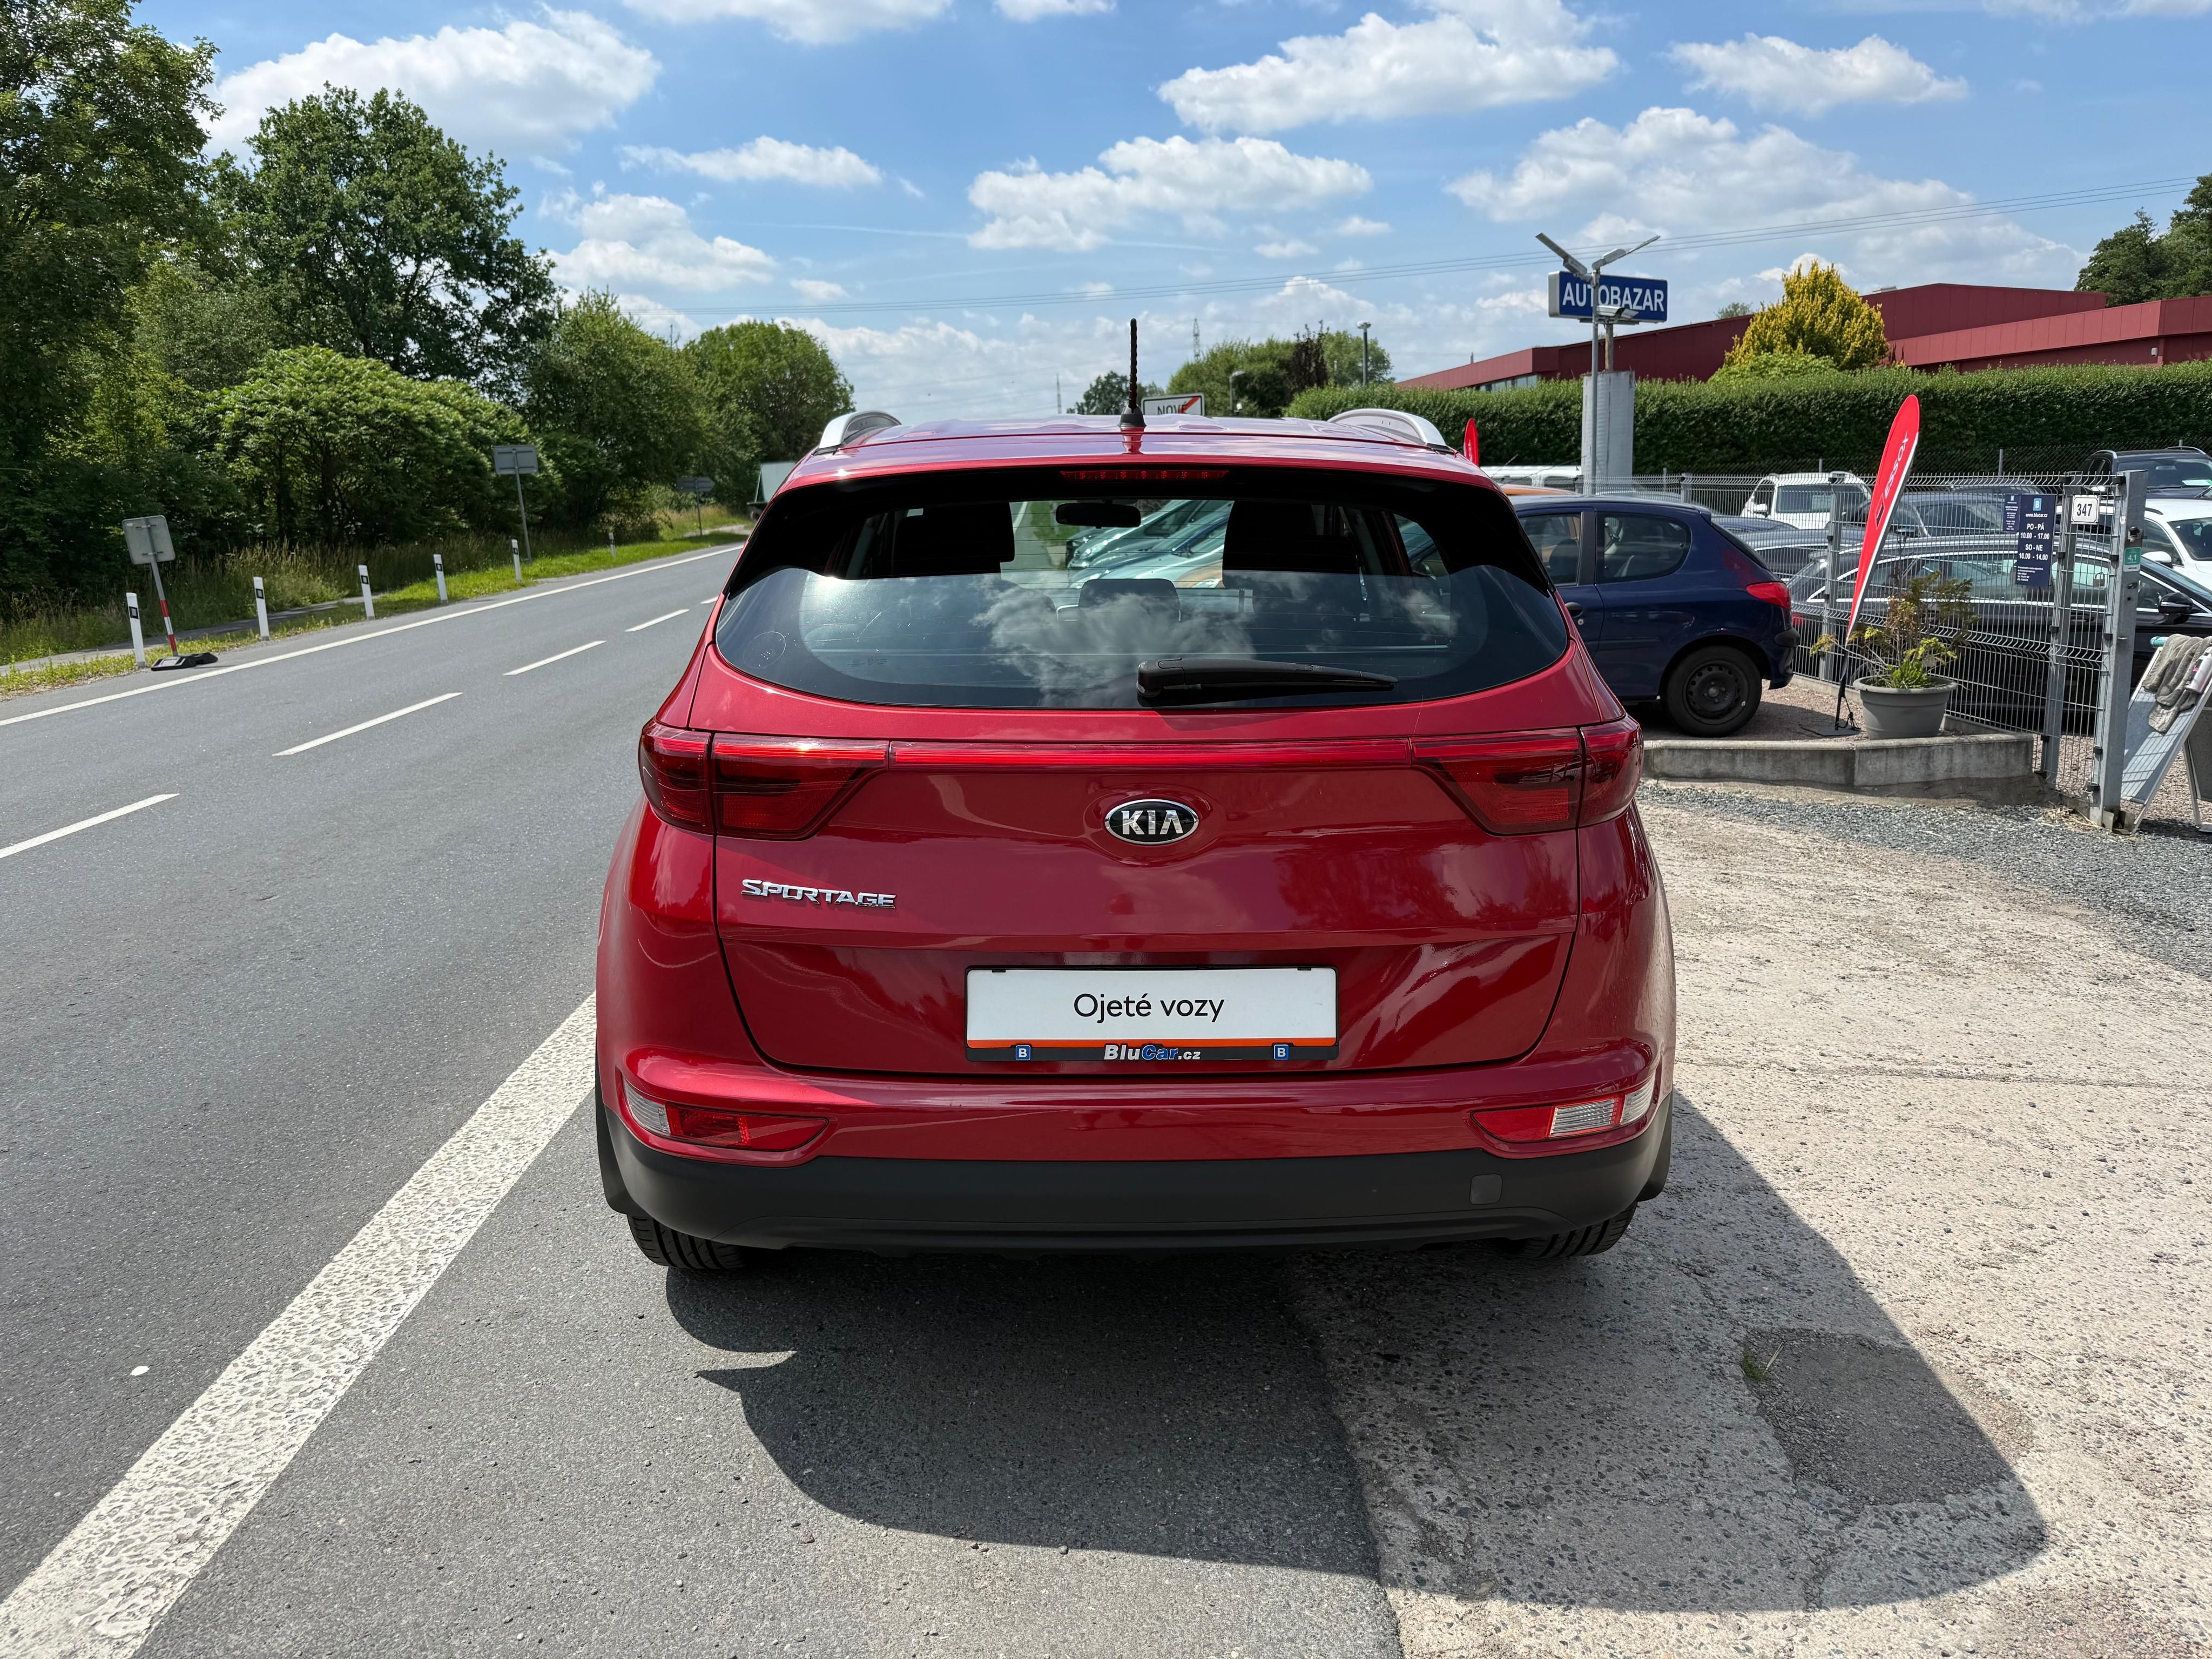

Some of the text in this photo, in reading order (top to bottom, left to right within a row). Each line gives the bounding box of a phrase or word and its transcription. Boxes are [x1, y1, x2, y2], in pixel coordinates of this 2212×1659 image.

[1562, 282, 1664, 312] AUTOBAZAR
[2077, 503, 2093, 516] 347
[2038, 522, 2045, 530] PÁ
[1121, 810, 1184, 835] KIA
[741, 879, 897, 908] SPORTAGE
[1074, 993, 1225, 1023] Ojeté vozy
[1019, 1048, 1027, 1058] B
[1104, 1044, 1201, 1060] BluCar.cz
[1277, 1048, 1286, 1057] B
